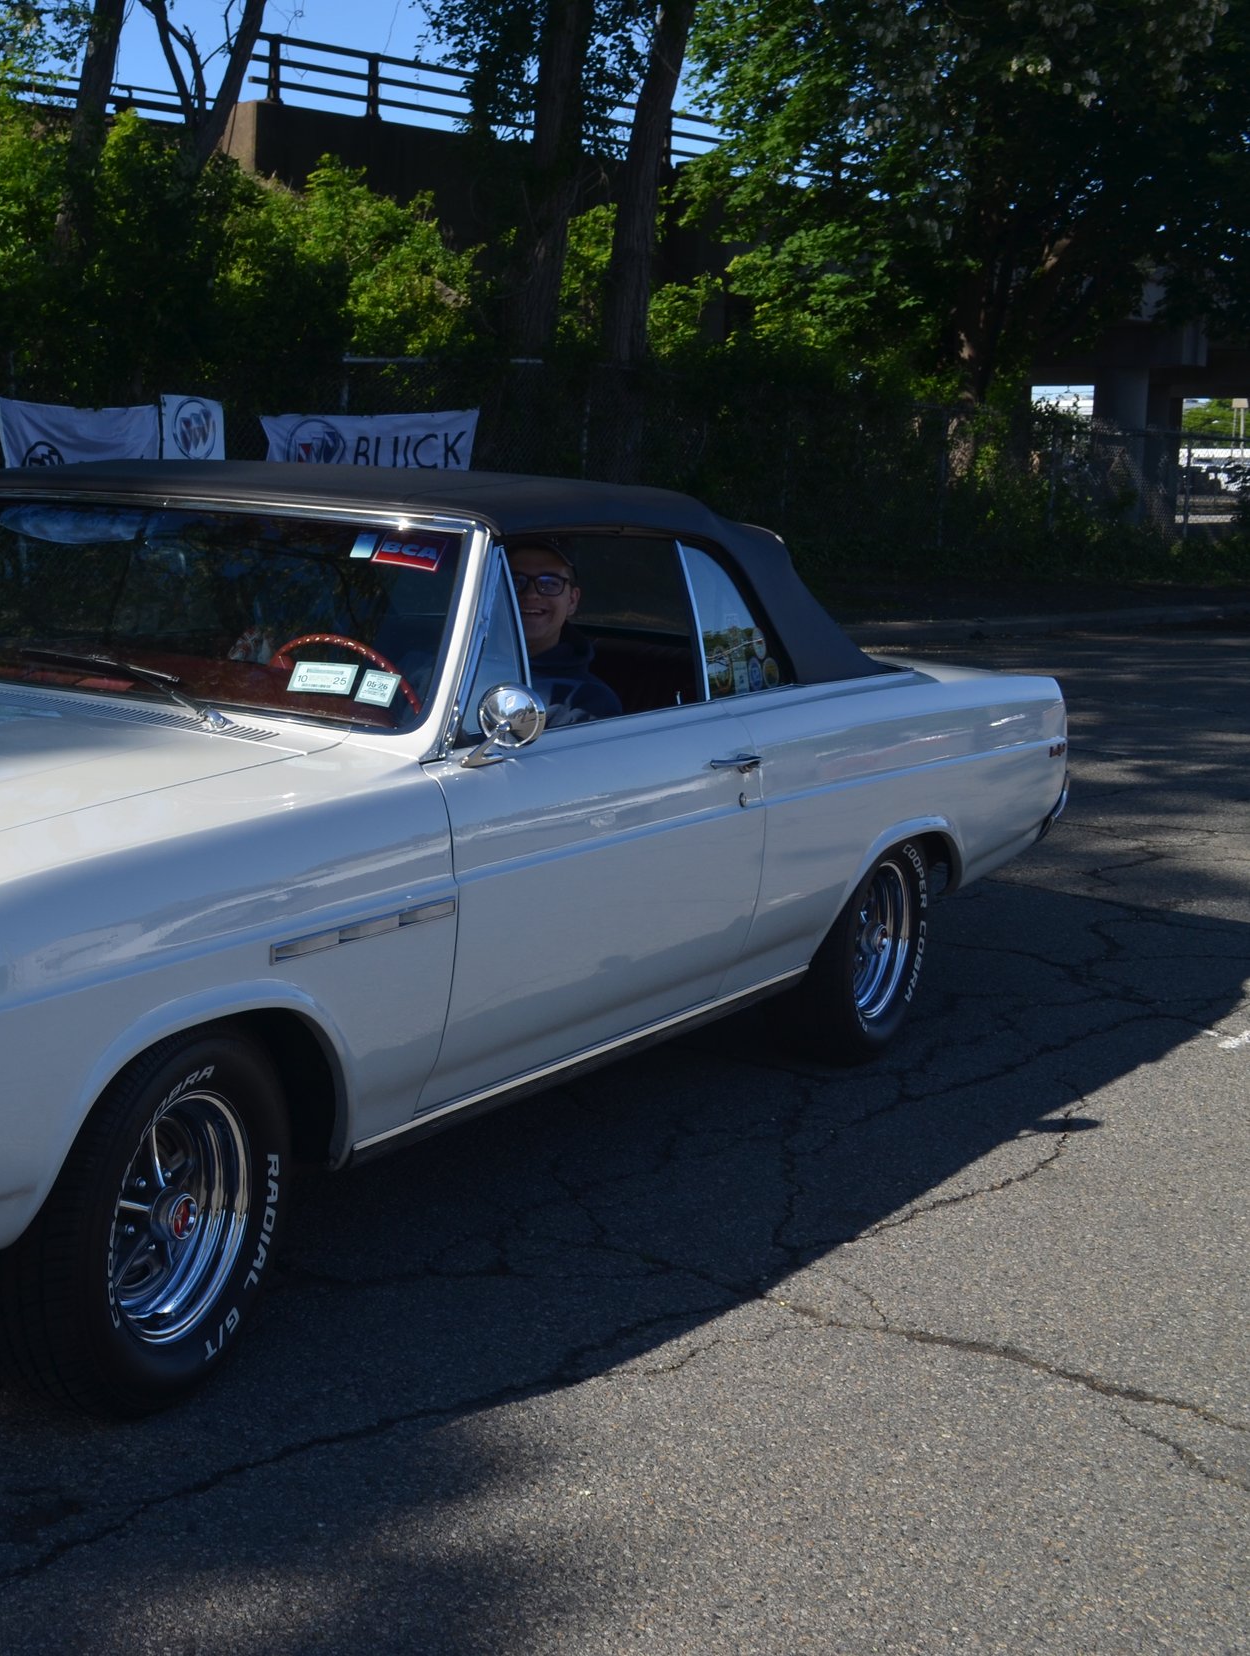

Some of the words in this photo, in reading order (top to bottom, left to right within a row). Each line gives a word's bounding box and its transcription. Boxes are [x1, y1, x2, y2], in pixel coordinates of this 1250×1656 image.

[353, 431, 467, 468] BUICK
[380, 540, 438, 560] BCA
[297, 674, 308, 682] 10
[332, 677, 347, 685] 25
[902, 843, 928, 908] COOPER
[904, 920, 927, 1003] COBRA
[244, 1153, 280, 1290] RADIAL
[204, 1306, 241, 1361] G/T
